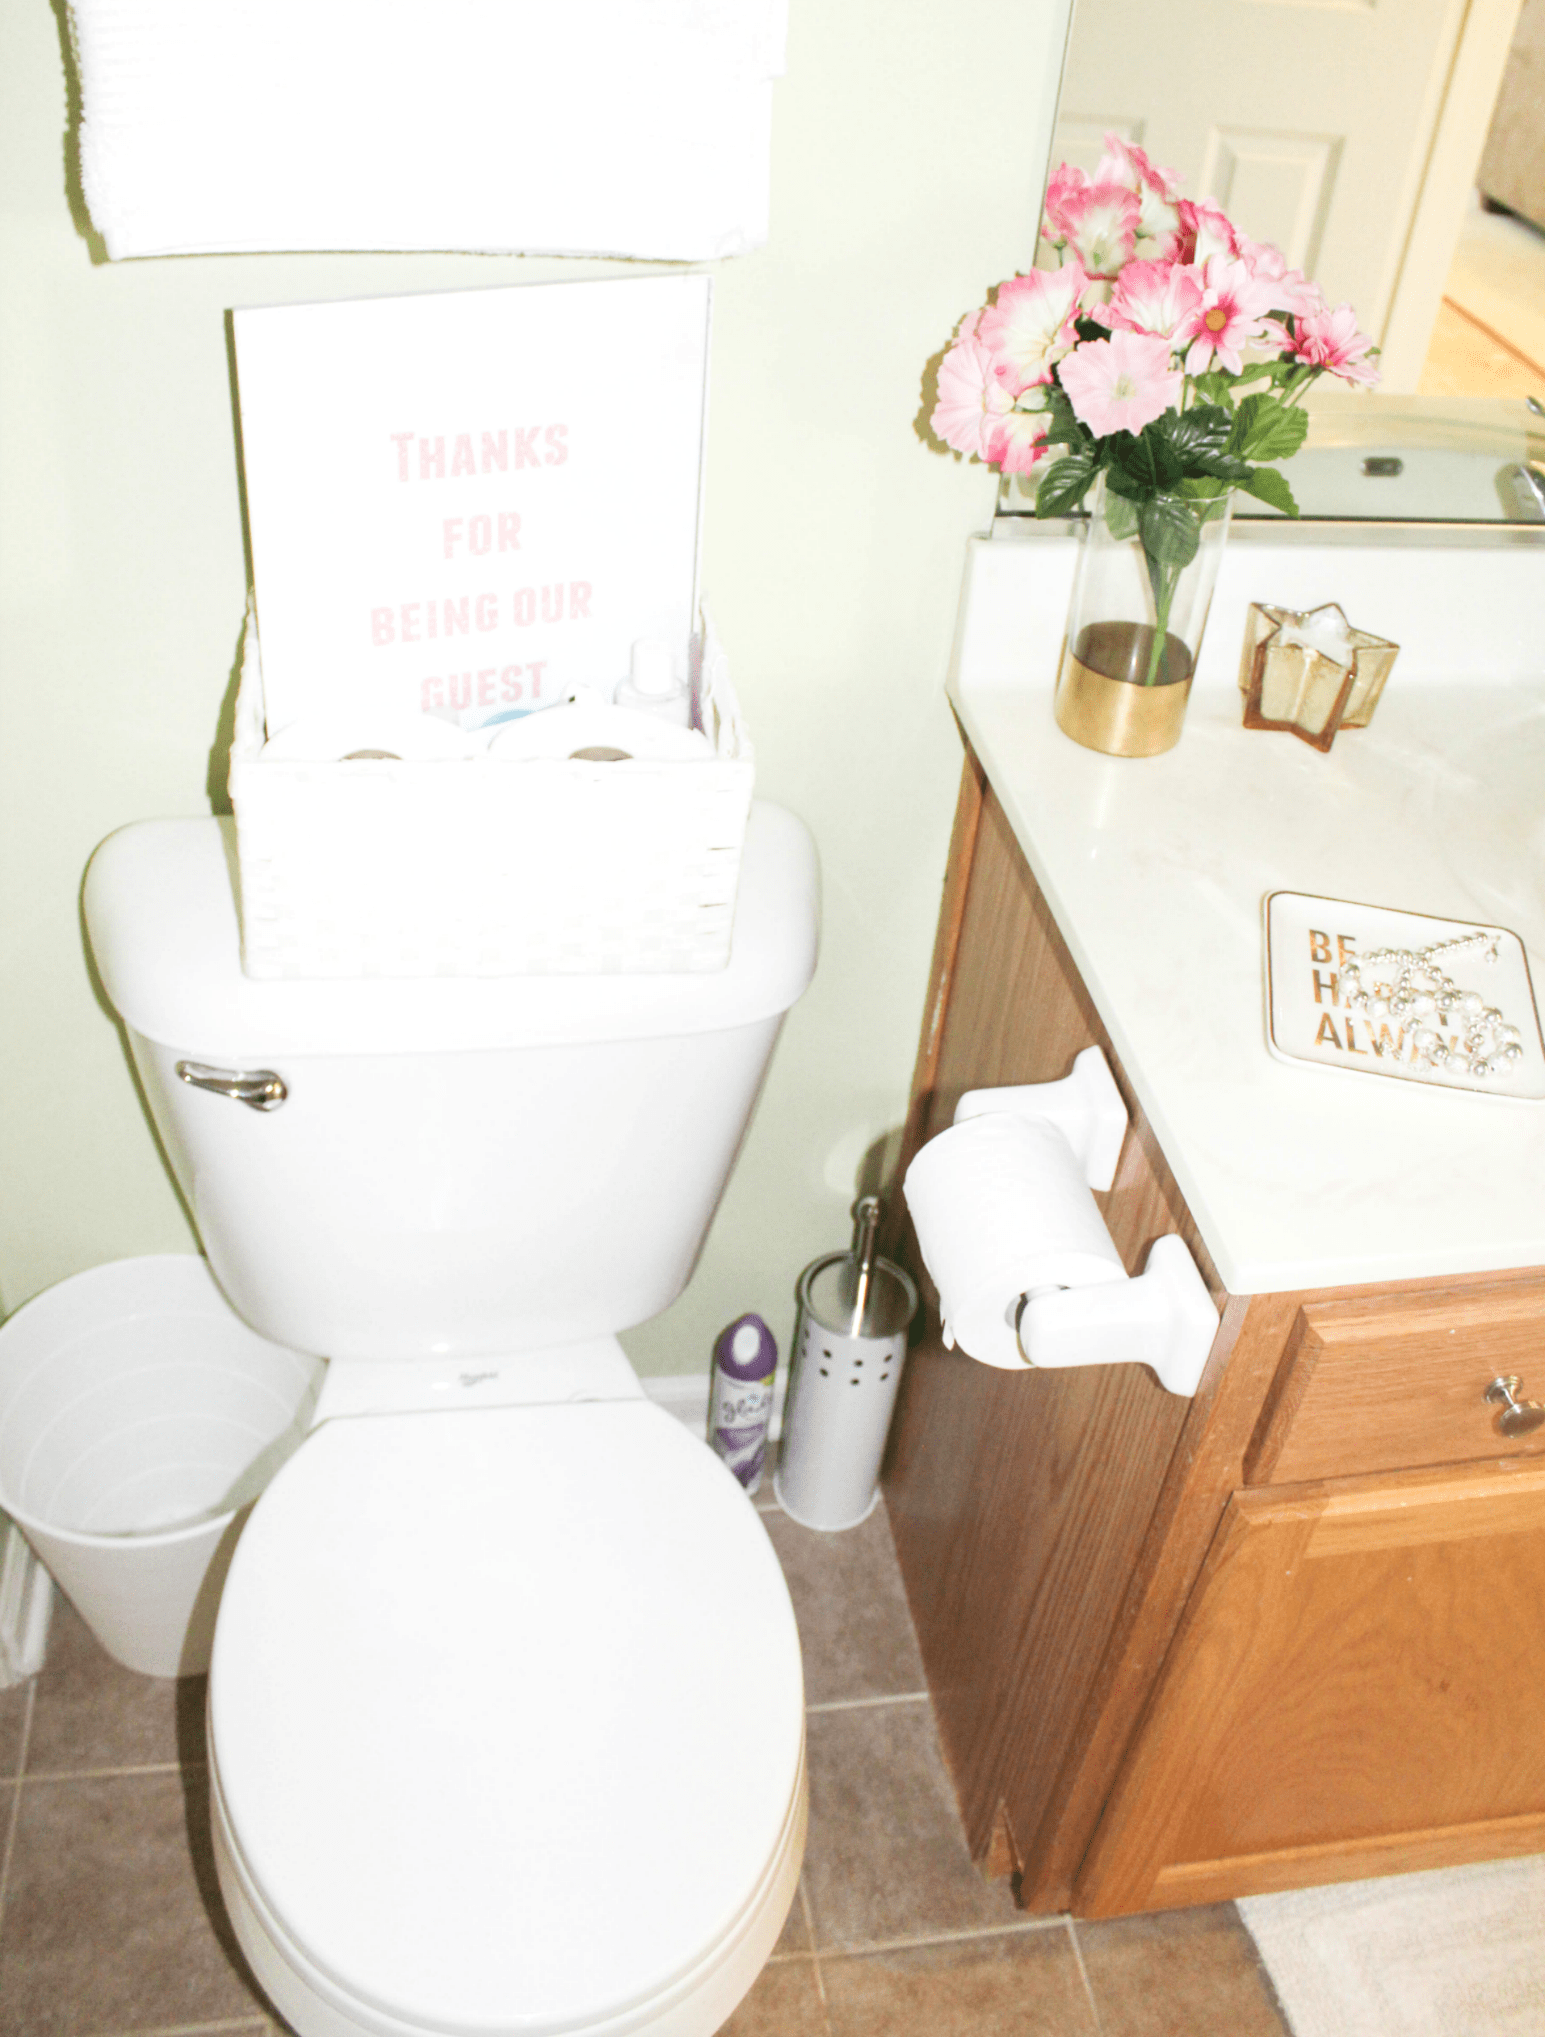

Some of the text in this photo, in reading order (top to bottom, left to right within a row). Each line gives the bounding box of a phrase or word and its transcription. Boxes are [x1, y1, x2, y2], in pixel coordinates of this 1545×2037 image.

[389, 423, 569, 482] THANKS
[442, 511, 522, 560] FOR
[370, 580, 593, 647] BEING OUR
[420, 660, 547, 713] GUEST
[1313, 1011, 1477, 1068] ALW
